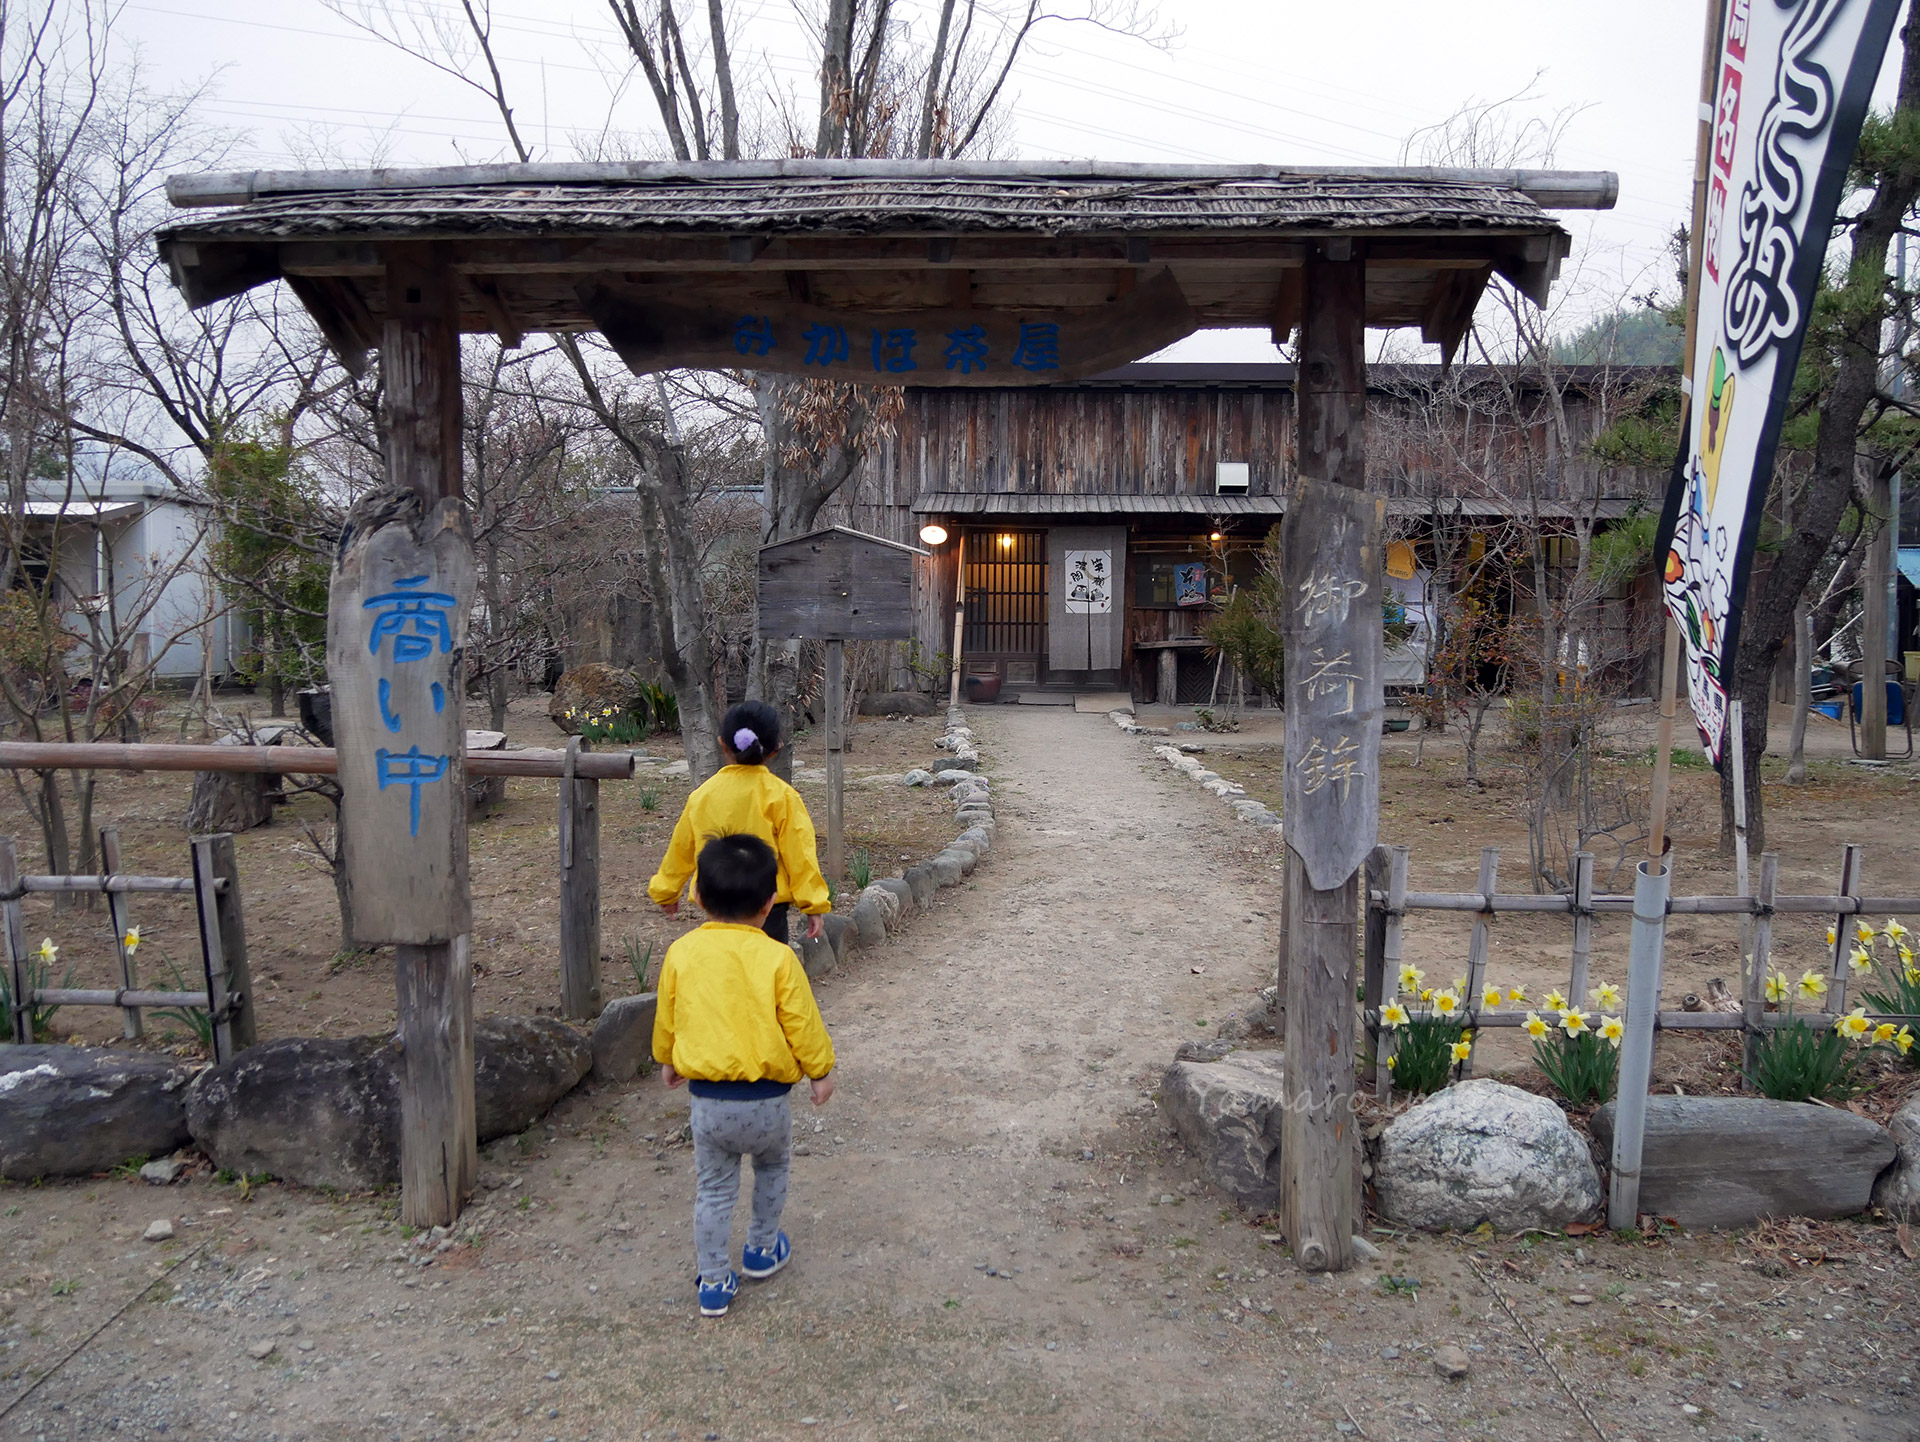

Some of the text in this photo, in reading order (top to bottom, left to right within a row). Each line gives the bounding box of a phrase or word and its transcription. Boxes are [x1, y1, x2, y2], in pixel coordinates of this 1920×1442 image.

[733, 314, 1061, 375] みかほ茶屋
[362, 575, 457, 837] 商い中
